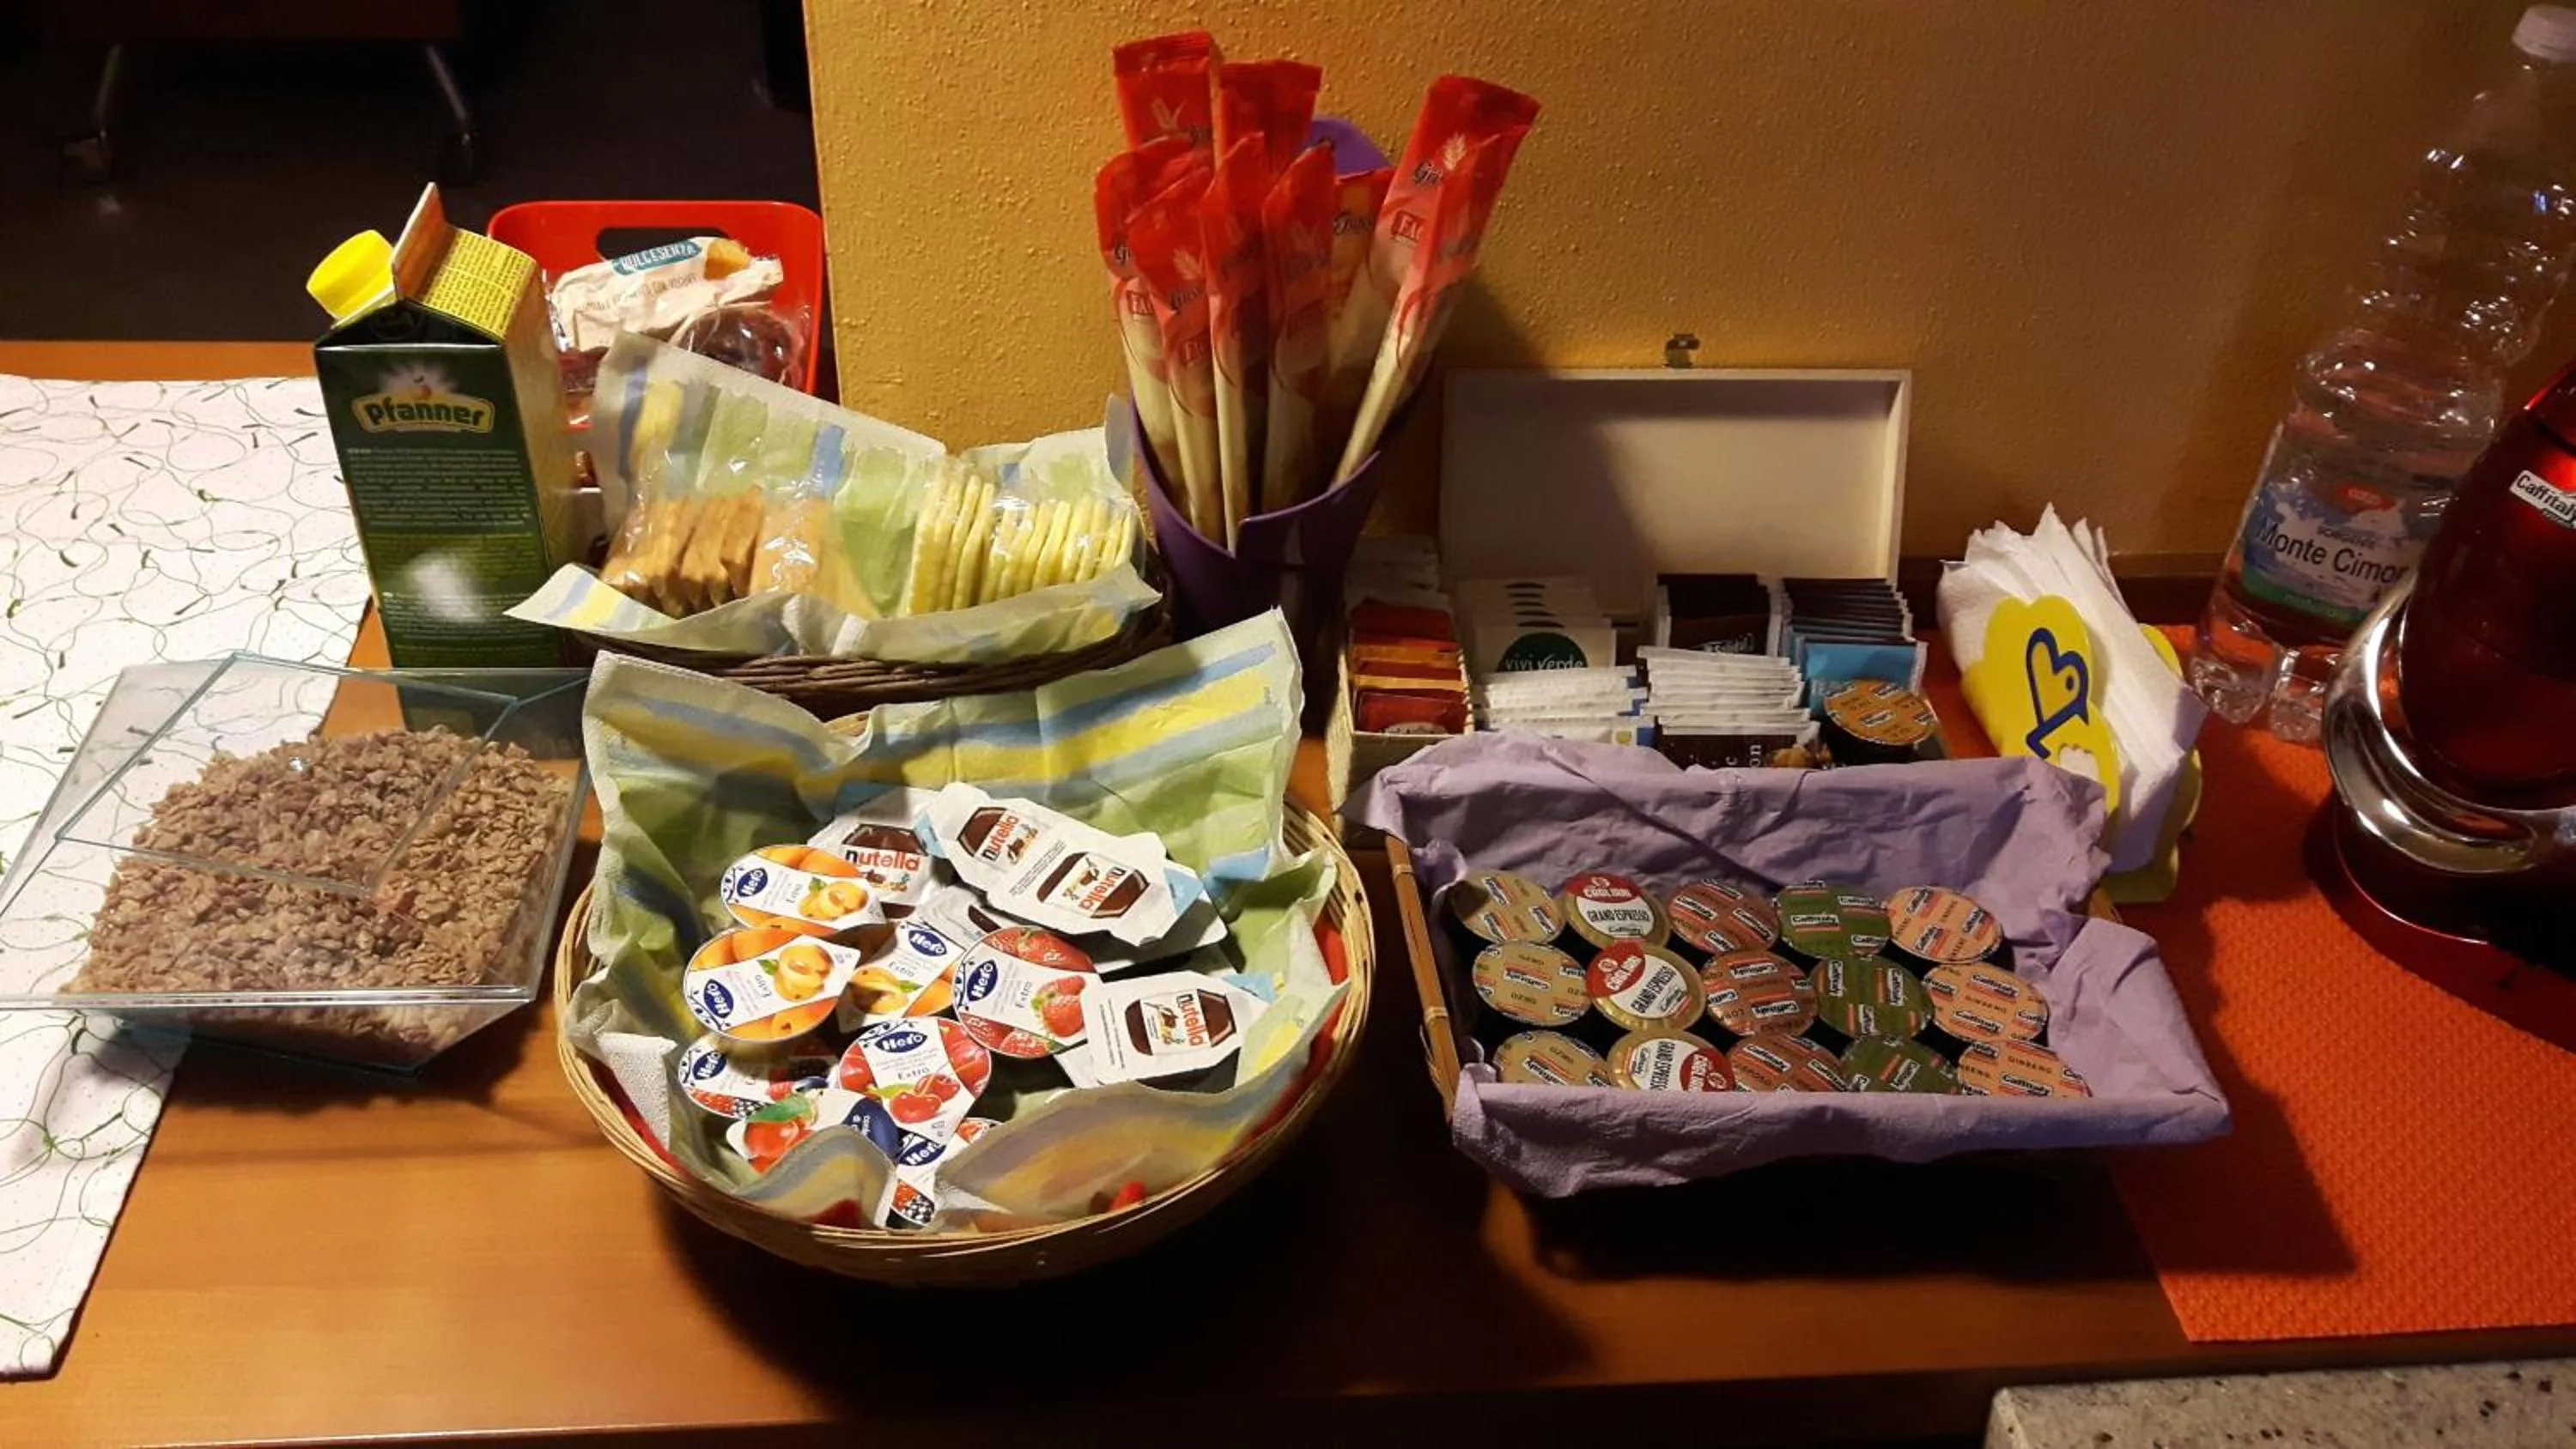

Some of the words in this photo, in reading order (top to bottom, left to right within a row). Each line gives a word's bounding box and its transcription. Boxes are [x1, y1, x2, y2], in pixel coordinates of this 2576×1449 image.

[364, 396, 485, 427] pfanner
[2517, 474, 2576, 516] Caffital
[2257, 517, 2327, 566] Monte
[981, 815, 1020, 862] nutella
[845, 850, 920, 871] nutella
[741, 869, 764, 895] Hero
[1078, 866, 1127, 911] nutella
[911, 932, 945, 955] Hero
[970, 962, 993, 998] Hero
[707, 982, 730, 1015] Hero
[1176, 993, 1208, 1046] nutella
[881, 1033, 924, 1051] Hero
[696, 1051, 723, 1078] Hero
